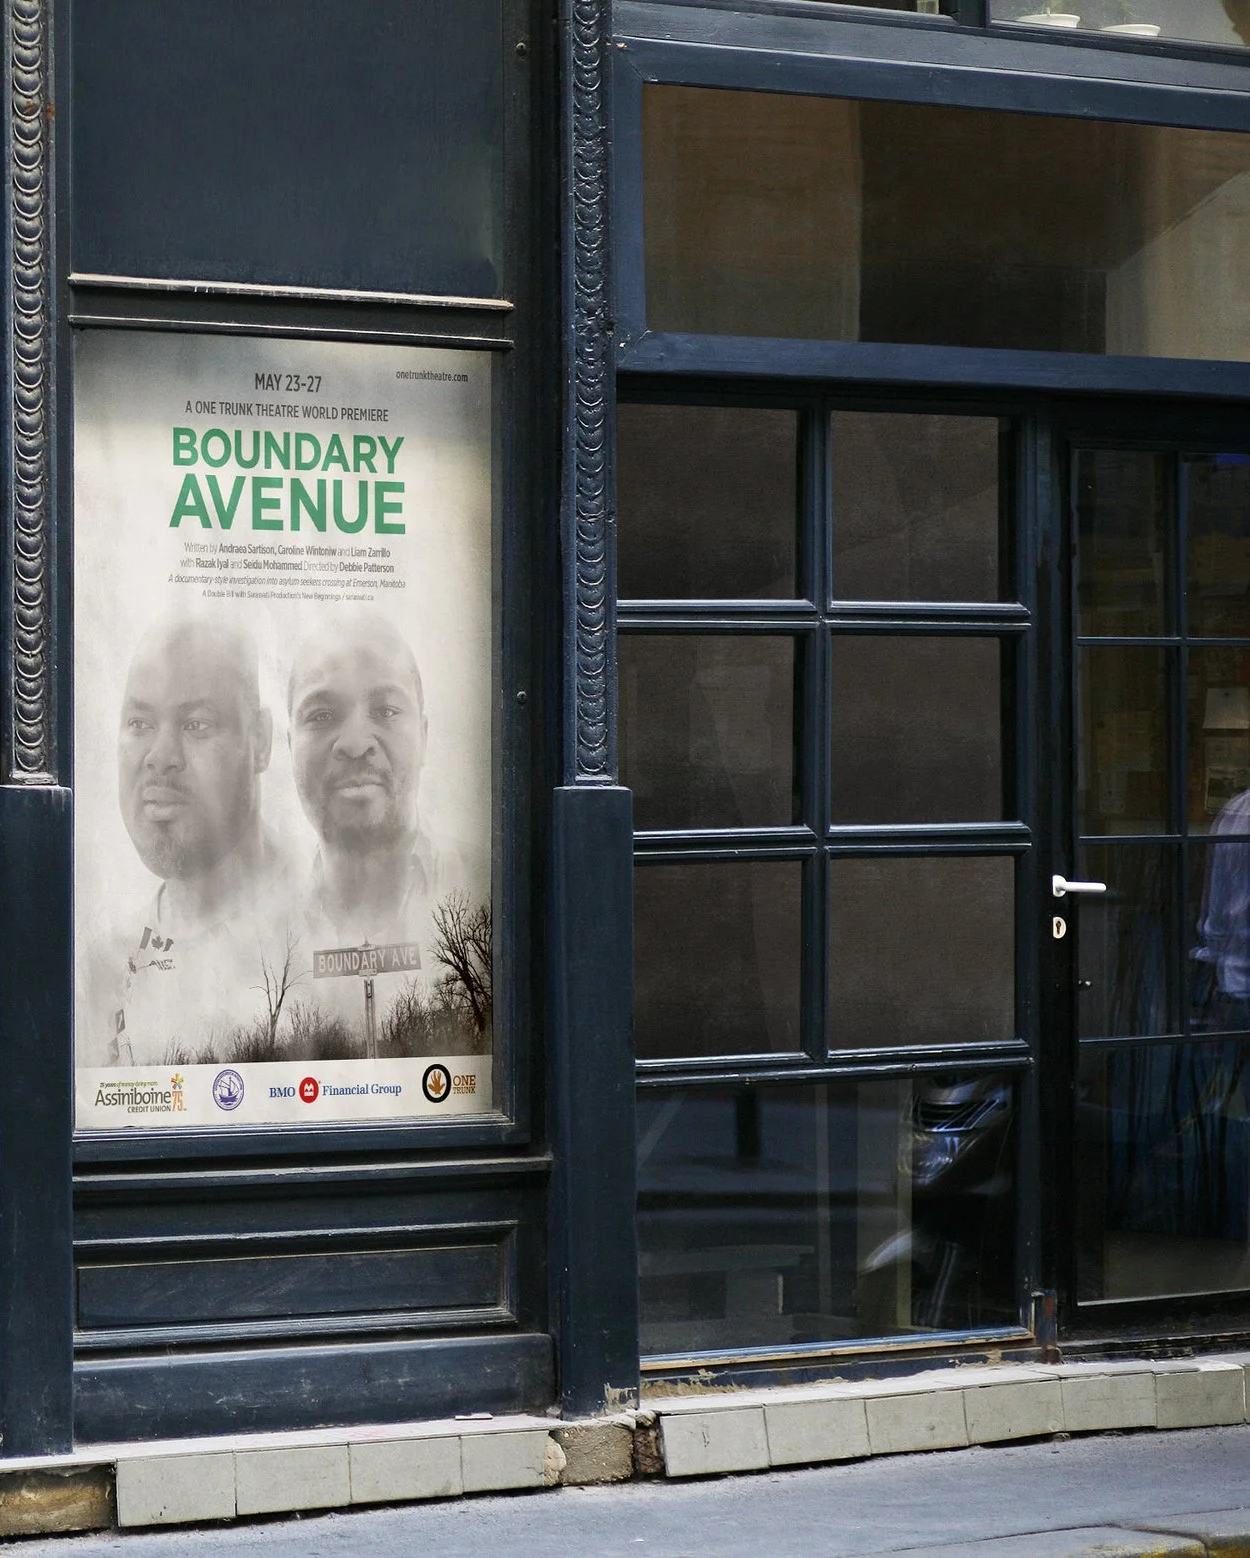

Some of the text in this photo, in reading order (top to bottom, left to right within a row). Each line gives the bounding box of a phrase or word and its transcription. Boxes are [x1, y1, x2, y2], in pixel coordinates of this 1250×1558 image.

[255, 372, 322, 393] MAY 23-27
[395, 370, 469, 383] onetrunktheatre.com
[185, 400, 389, 422] A ONE TRUNK THEATRE WORLD PREMIERE
[172, 427, 405, 474] BOUNDARY
[169, 473, 406, 535] AVENUE
[184, 542, 209, 553] Written
[209, 543, 219, 555] by
[219, 543, 247, 554] Andraea
[247, 544, 277, 556] Sartison,
[277, 544, 304, 556] Caroline
[337, 546, 350, 557] and
[351, 546, 367, 557] Liam
[180, 558, 195, 568] with
[195, 558, 216, 569] Razak
[230, 559, 243, 569] and
[243, 559, 262, 570] Seidu
[263, 560, 303, 571] Mohammed
[303, 560, 329, 572] Directed
[330, 561, 339, 573] by
[339, 561, 362, 572] Debbie
[363, 562, 395, 573] Patterson
[168, 574, 173, 582] A
[174, 574, 213, 585] documentary
[214, 575, 229, 586] style
[229, 575, 266, 586] investigation
[267, 576, 278, 585] into
[278, 577, 299, 587] asylum
[300, 577, 322, 587] seekers
[322, 577, 345, 588] crossing
[345, 578, 352, 587] at
[379, 579, 406, 589] Manitoba
[318, 947, 417, 973] BOUNDARY AVE
[453, 1074, 476, 1086] ONE
[95, 1087, 171, 1106] Assiniboine
[269, 1083, 402, 1098] BMO Financial Group
[453, 1086, 476, 1095] TRUNK
[127, 1105, 171, 1113] CREDIT UNION
